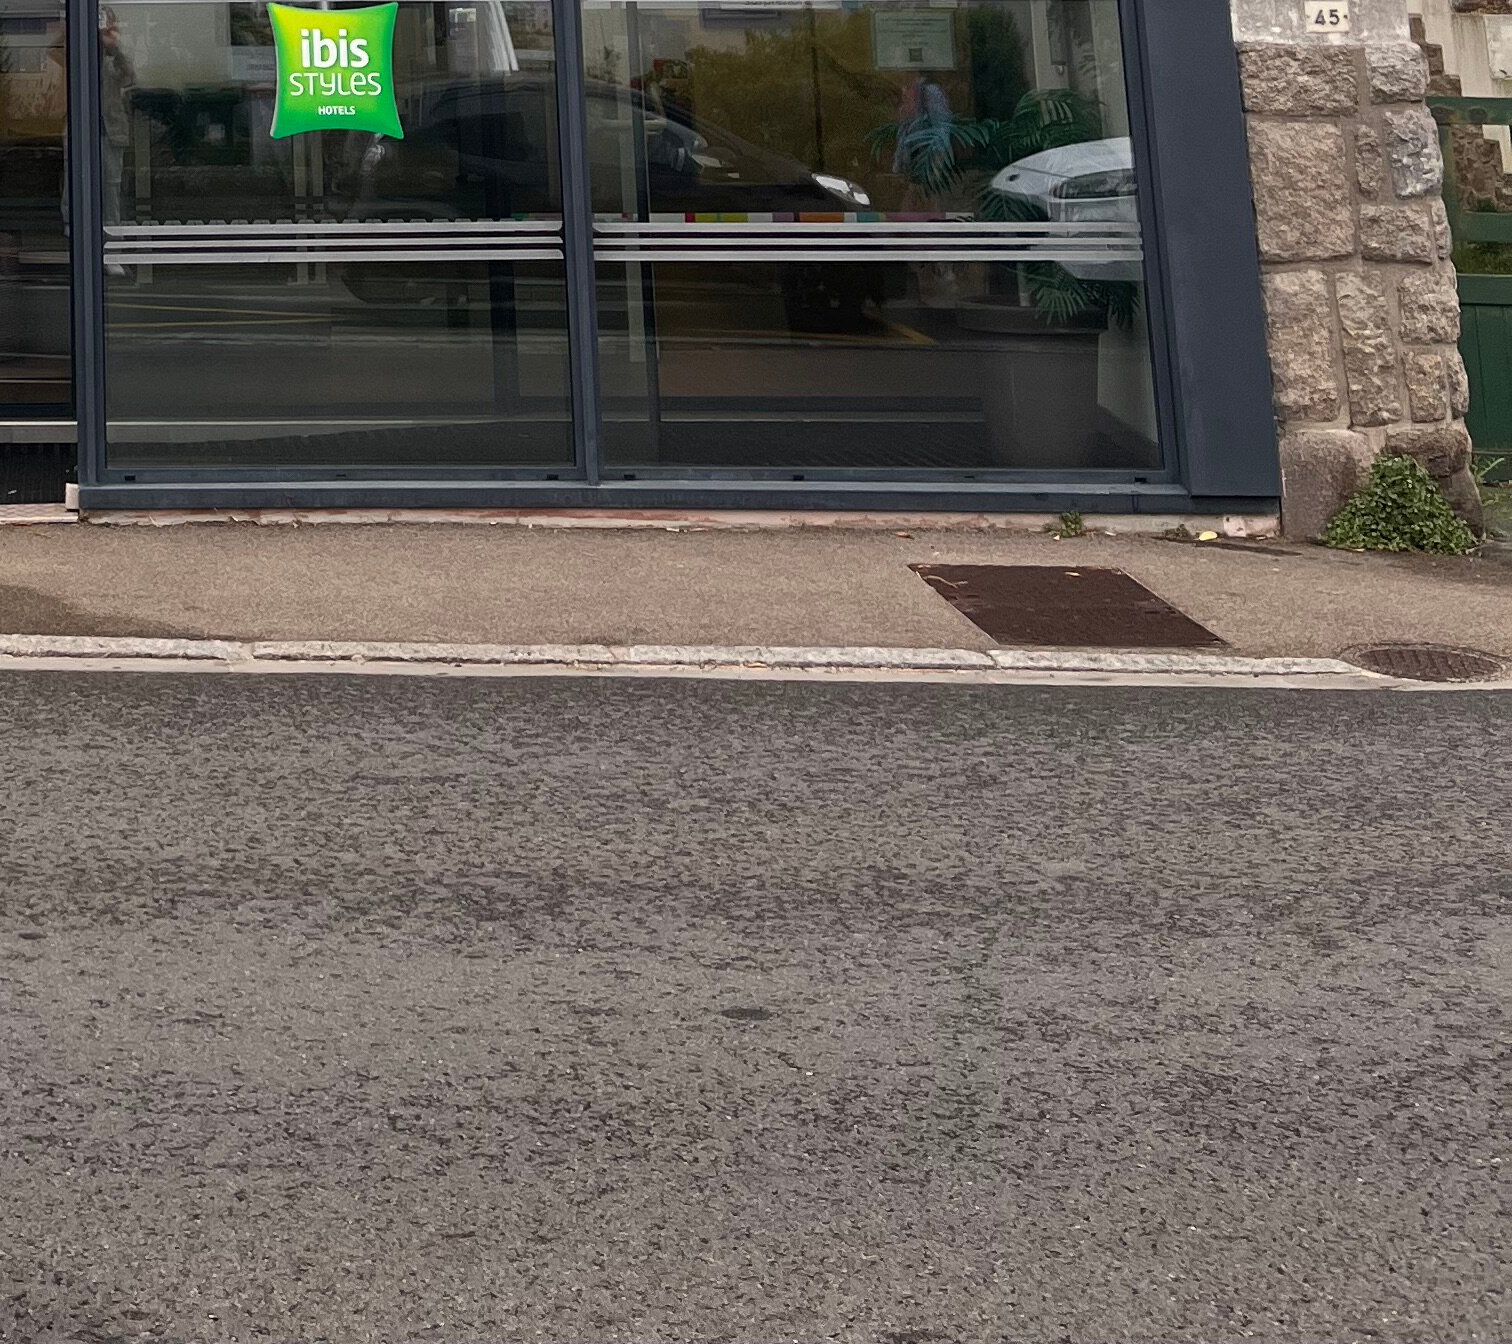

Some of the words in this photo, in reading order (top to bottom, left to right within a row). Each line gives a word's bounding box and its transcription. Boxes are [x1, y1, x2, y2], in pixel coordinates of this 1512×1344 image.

[1314, 9, 1340, 26] 45
[300, 28, 370, 68] ibis
[318, 105, 356, 115] HOTELS
